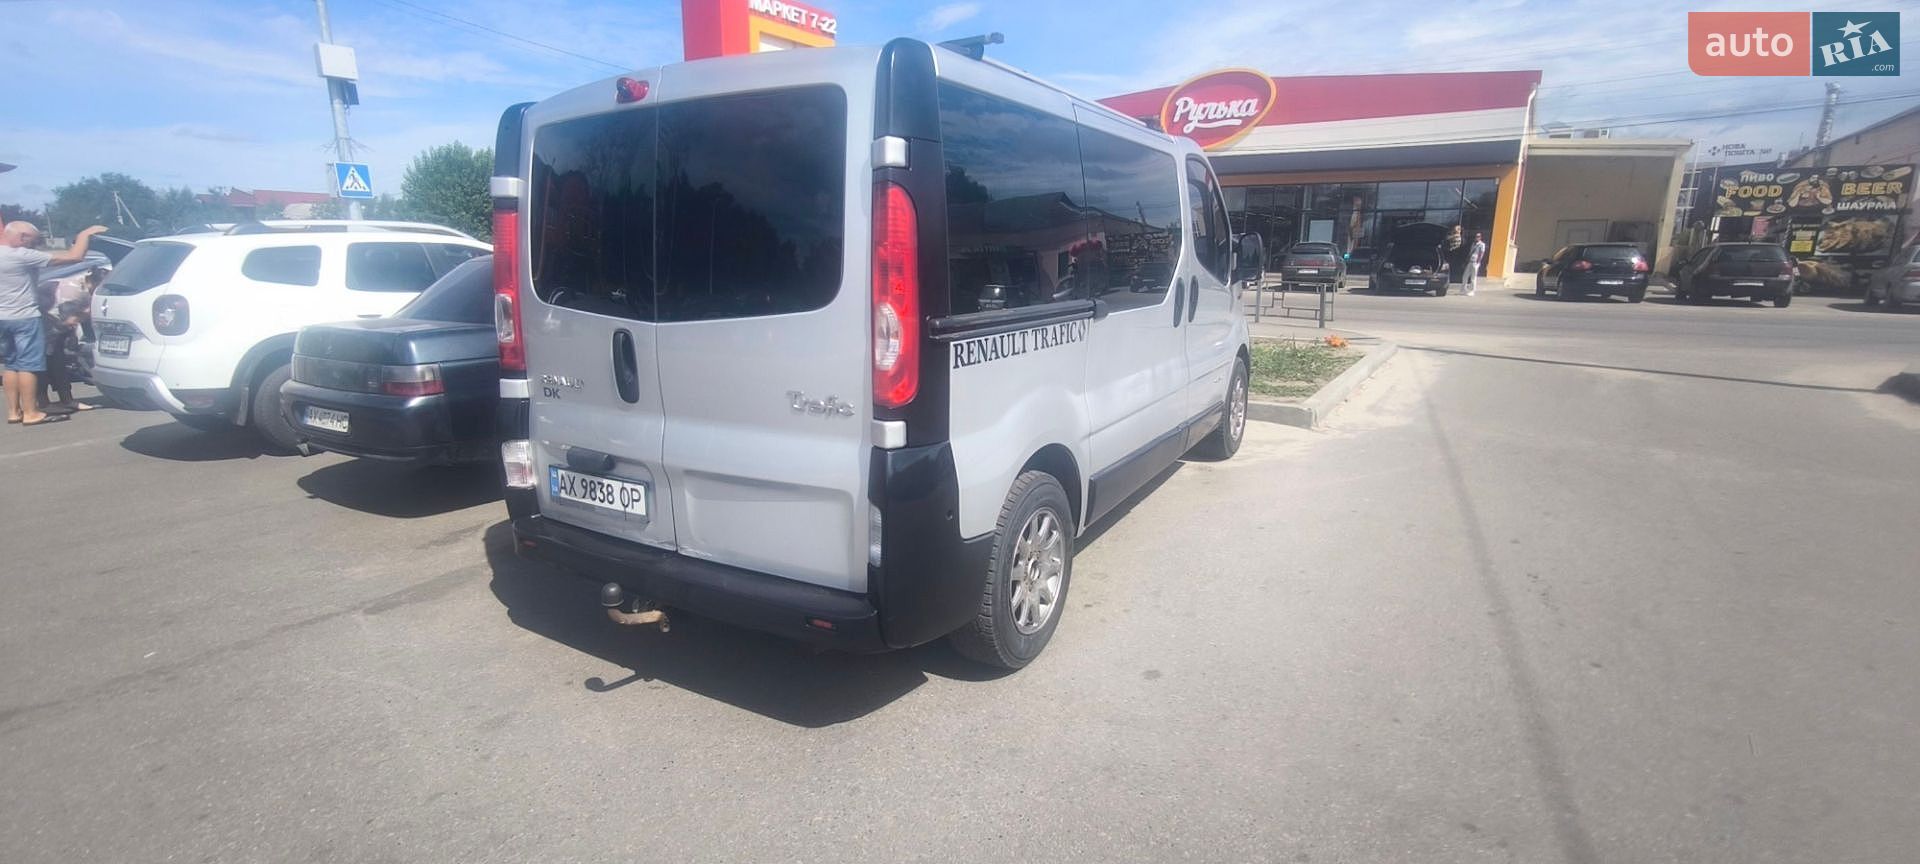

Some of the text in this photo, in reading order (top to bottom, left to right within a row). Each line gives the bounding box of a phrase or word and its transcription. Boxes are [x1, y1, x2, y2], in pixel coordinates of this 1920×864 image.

[809, 13, 837, 34] 7-22
[1173, 96, 1259, 134] Рулька
[1724, 181, 1903, 199] FOOD BEER
[1836, 201, 1897, 211] ШАУРМА
[953, 321, 1077, 370] RENAULT TRAFIC
[543, 387, 561, 399] DK
[560, 474, 577, 497] AX
[581, 478, 615, 504] 9838
